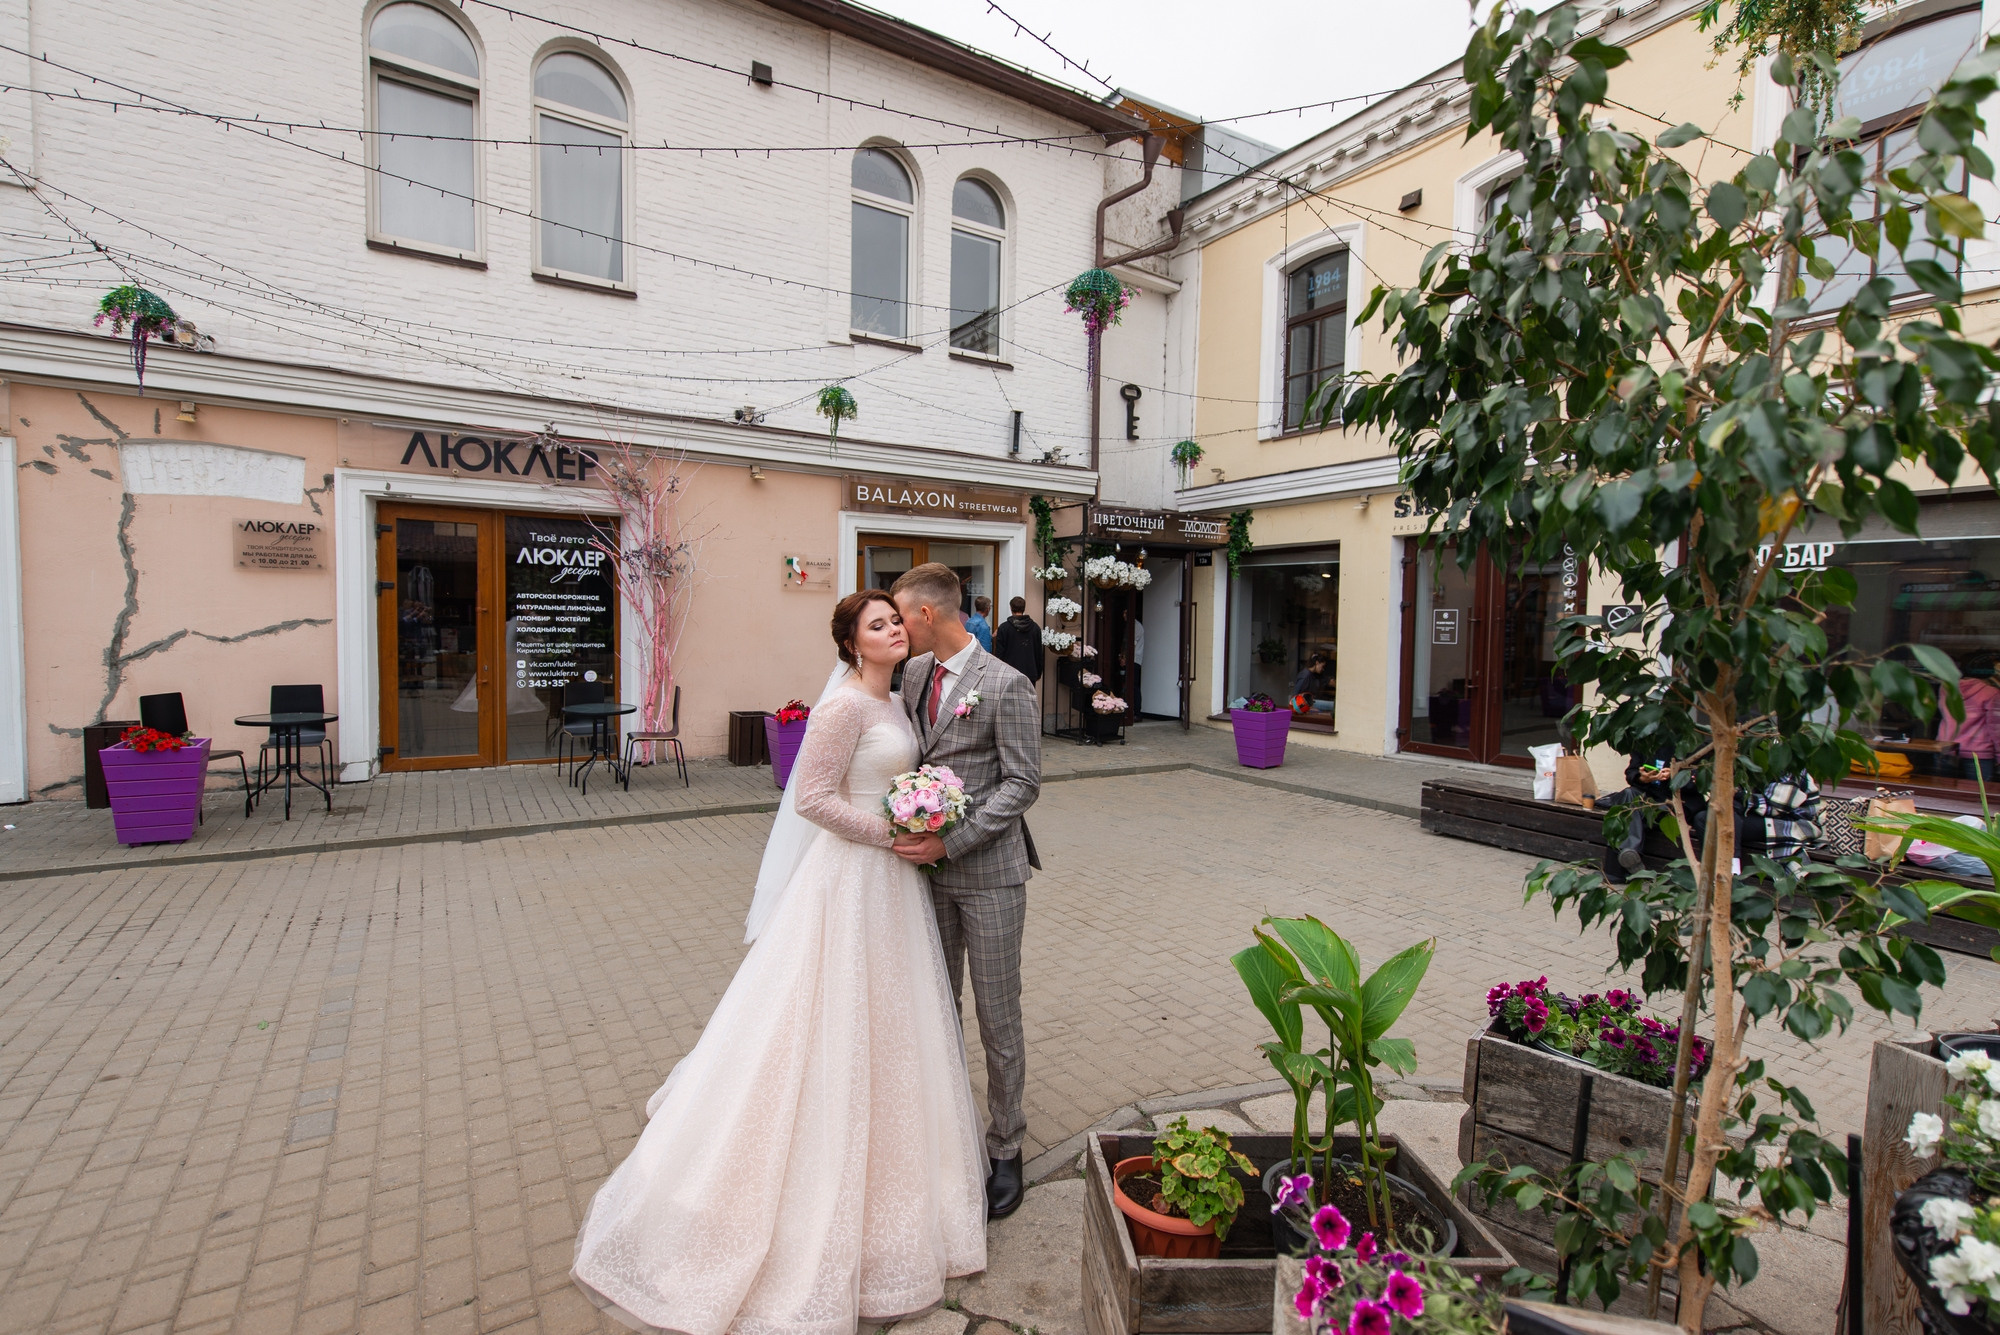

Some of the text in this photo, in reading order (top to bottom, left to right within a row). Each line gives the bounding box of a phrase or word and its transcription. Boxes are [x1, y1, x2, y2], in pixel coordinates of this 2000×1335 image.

[1845, 47, 1928, 96] 1984
[1308, 268, 1340, 291] 1984
[400, 432, 598, 480] ЛЮКЛЕР
[857, 485, 1018, 514] BALAXON STREETWEAR
[244, 520, 314, 534] ЛЮКЛЕР
[1094, 513, 1164, 530] ЦВЕТОЧНЫЙ
[530, 532, 556, 542] Твоё
[516, 547, 606, 567] ЛЮКЛЕР
[550, 567, 600, 584] десерт
